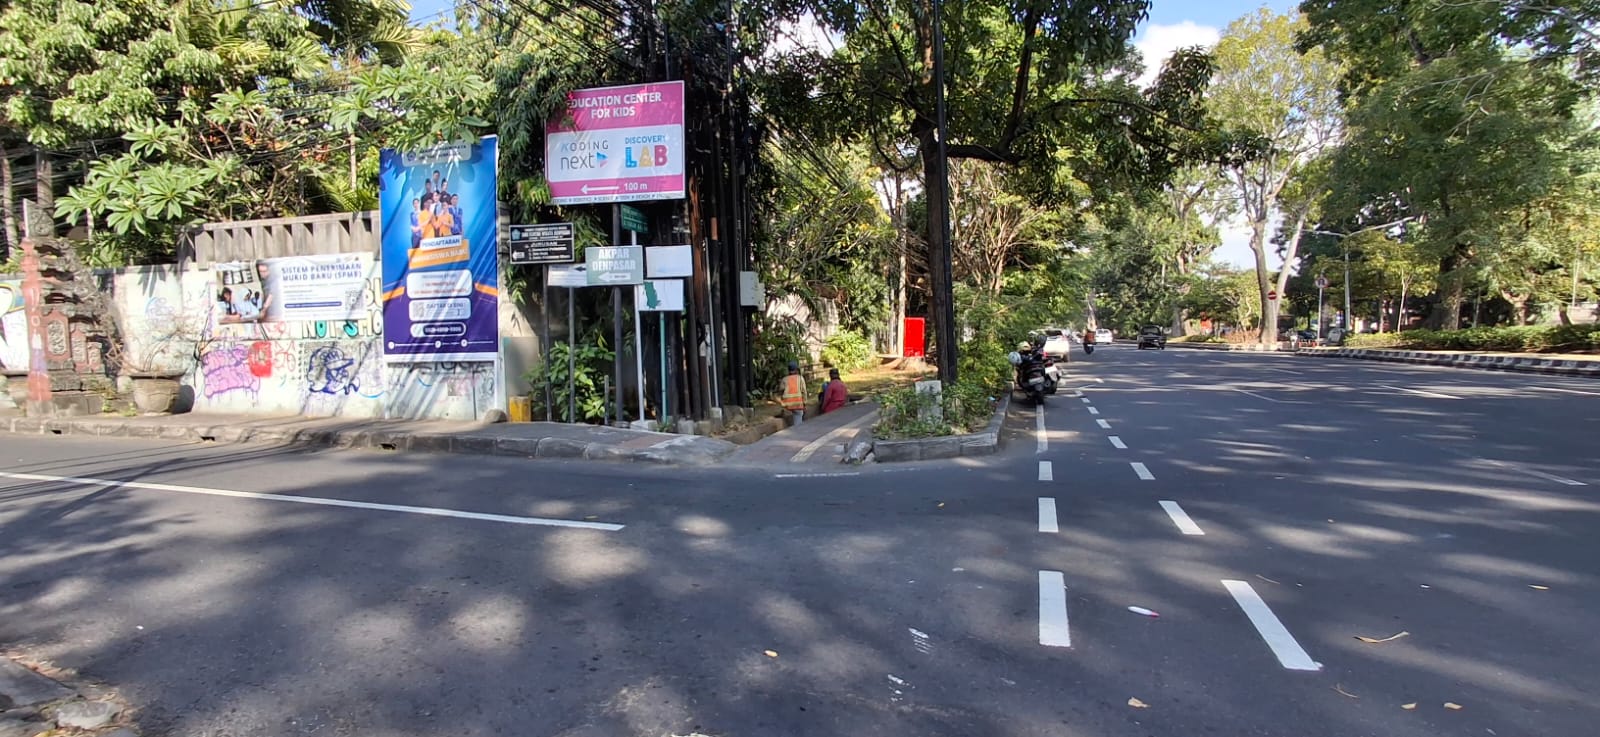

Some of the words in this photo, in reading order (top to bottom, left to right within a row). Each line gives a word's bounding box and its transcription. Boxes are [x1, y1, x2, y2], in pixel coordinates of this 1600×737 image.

[623, 92, 662, 105] CENTER
[591, 109, 610, 119] FOR
[613, 106, 636, 118] KIDS
[560, 140, 609, 152] KODING
[560, 152, 595, 170] next
[625, 144, 668, 168] LAB
[624, 182, 638, 191] 100
[599, 248, 630, 260] AKPAR
[282, 265, 308, 274] SISTEM
[311, 262, 362, 273] PENERIMAAN
[592, 260, 636, 272] DENPASAR
[283, 273, 308, 281] MURID
[310, 272, 332, 280] BARU
[335, 270, 362, 279] (SPMB)
